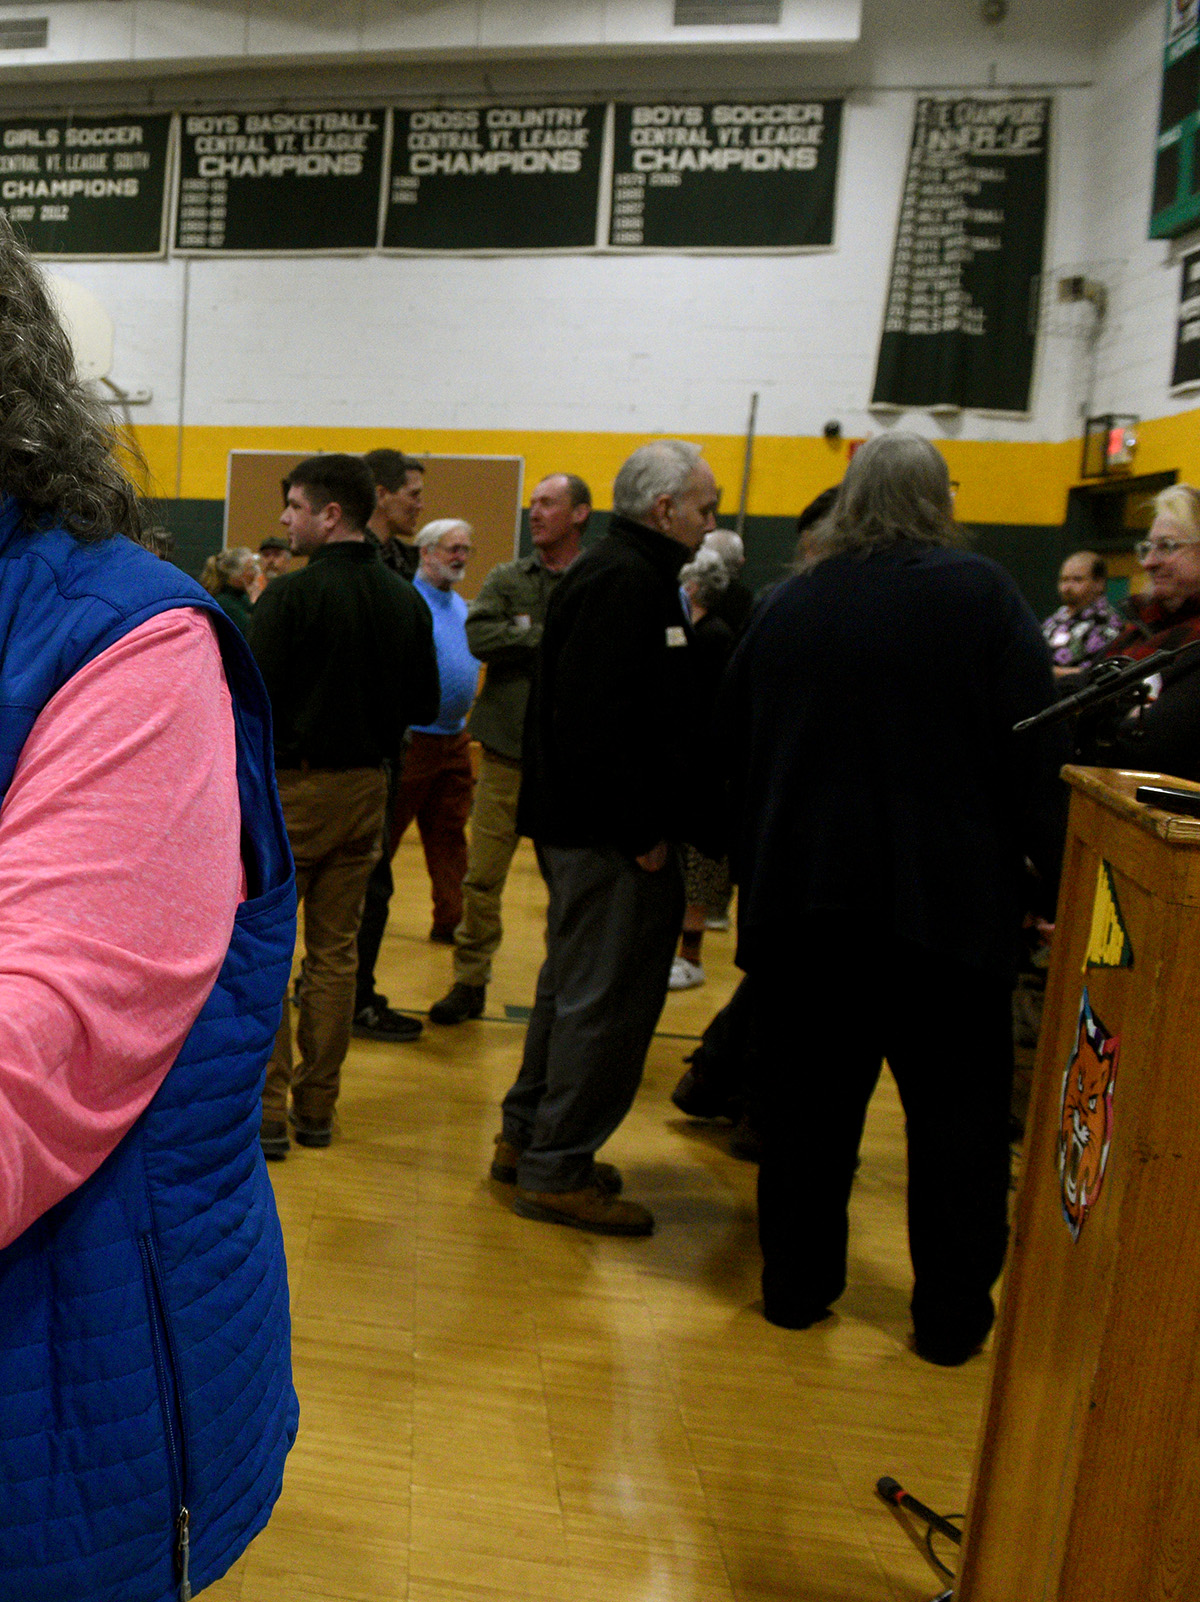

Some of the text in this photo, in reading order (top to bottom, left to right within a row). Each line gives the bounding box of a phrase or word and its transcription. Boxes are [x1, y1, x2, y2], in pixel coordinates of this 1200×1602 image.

[186, 112, 378, 135] BOYS BASKETBALL
[409, 107, 588, 131] CROSS COUNTRY
[632, 103, 824, 127] BOYS SOCCER
[3, 126, 143, 148] GIRLS SOCCER
[195, 134, 268, 155] CENTRAL
[302, 132, 369, 152] LEAGUE
[408, 131, 483, 151] CENTRAL
[519, 128, 590, 149] LEAGUE
[630, 126, 713, 148] CENTRAL
[750, 124, 825, 146] LEAGUE
[65, 153, 109, 173] LEAGUE
[198, 153, 363, 177] CHAMPIONS
[410, 149, 581, 175] CHAMPIONS
[633, 147, 818, 172] CHAMPIONS
[2, 178, 139, 199] CHAMPIONS
